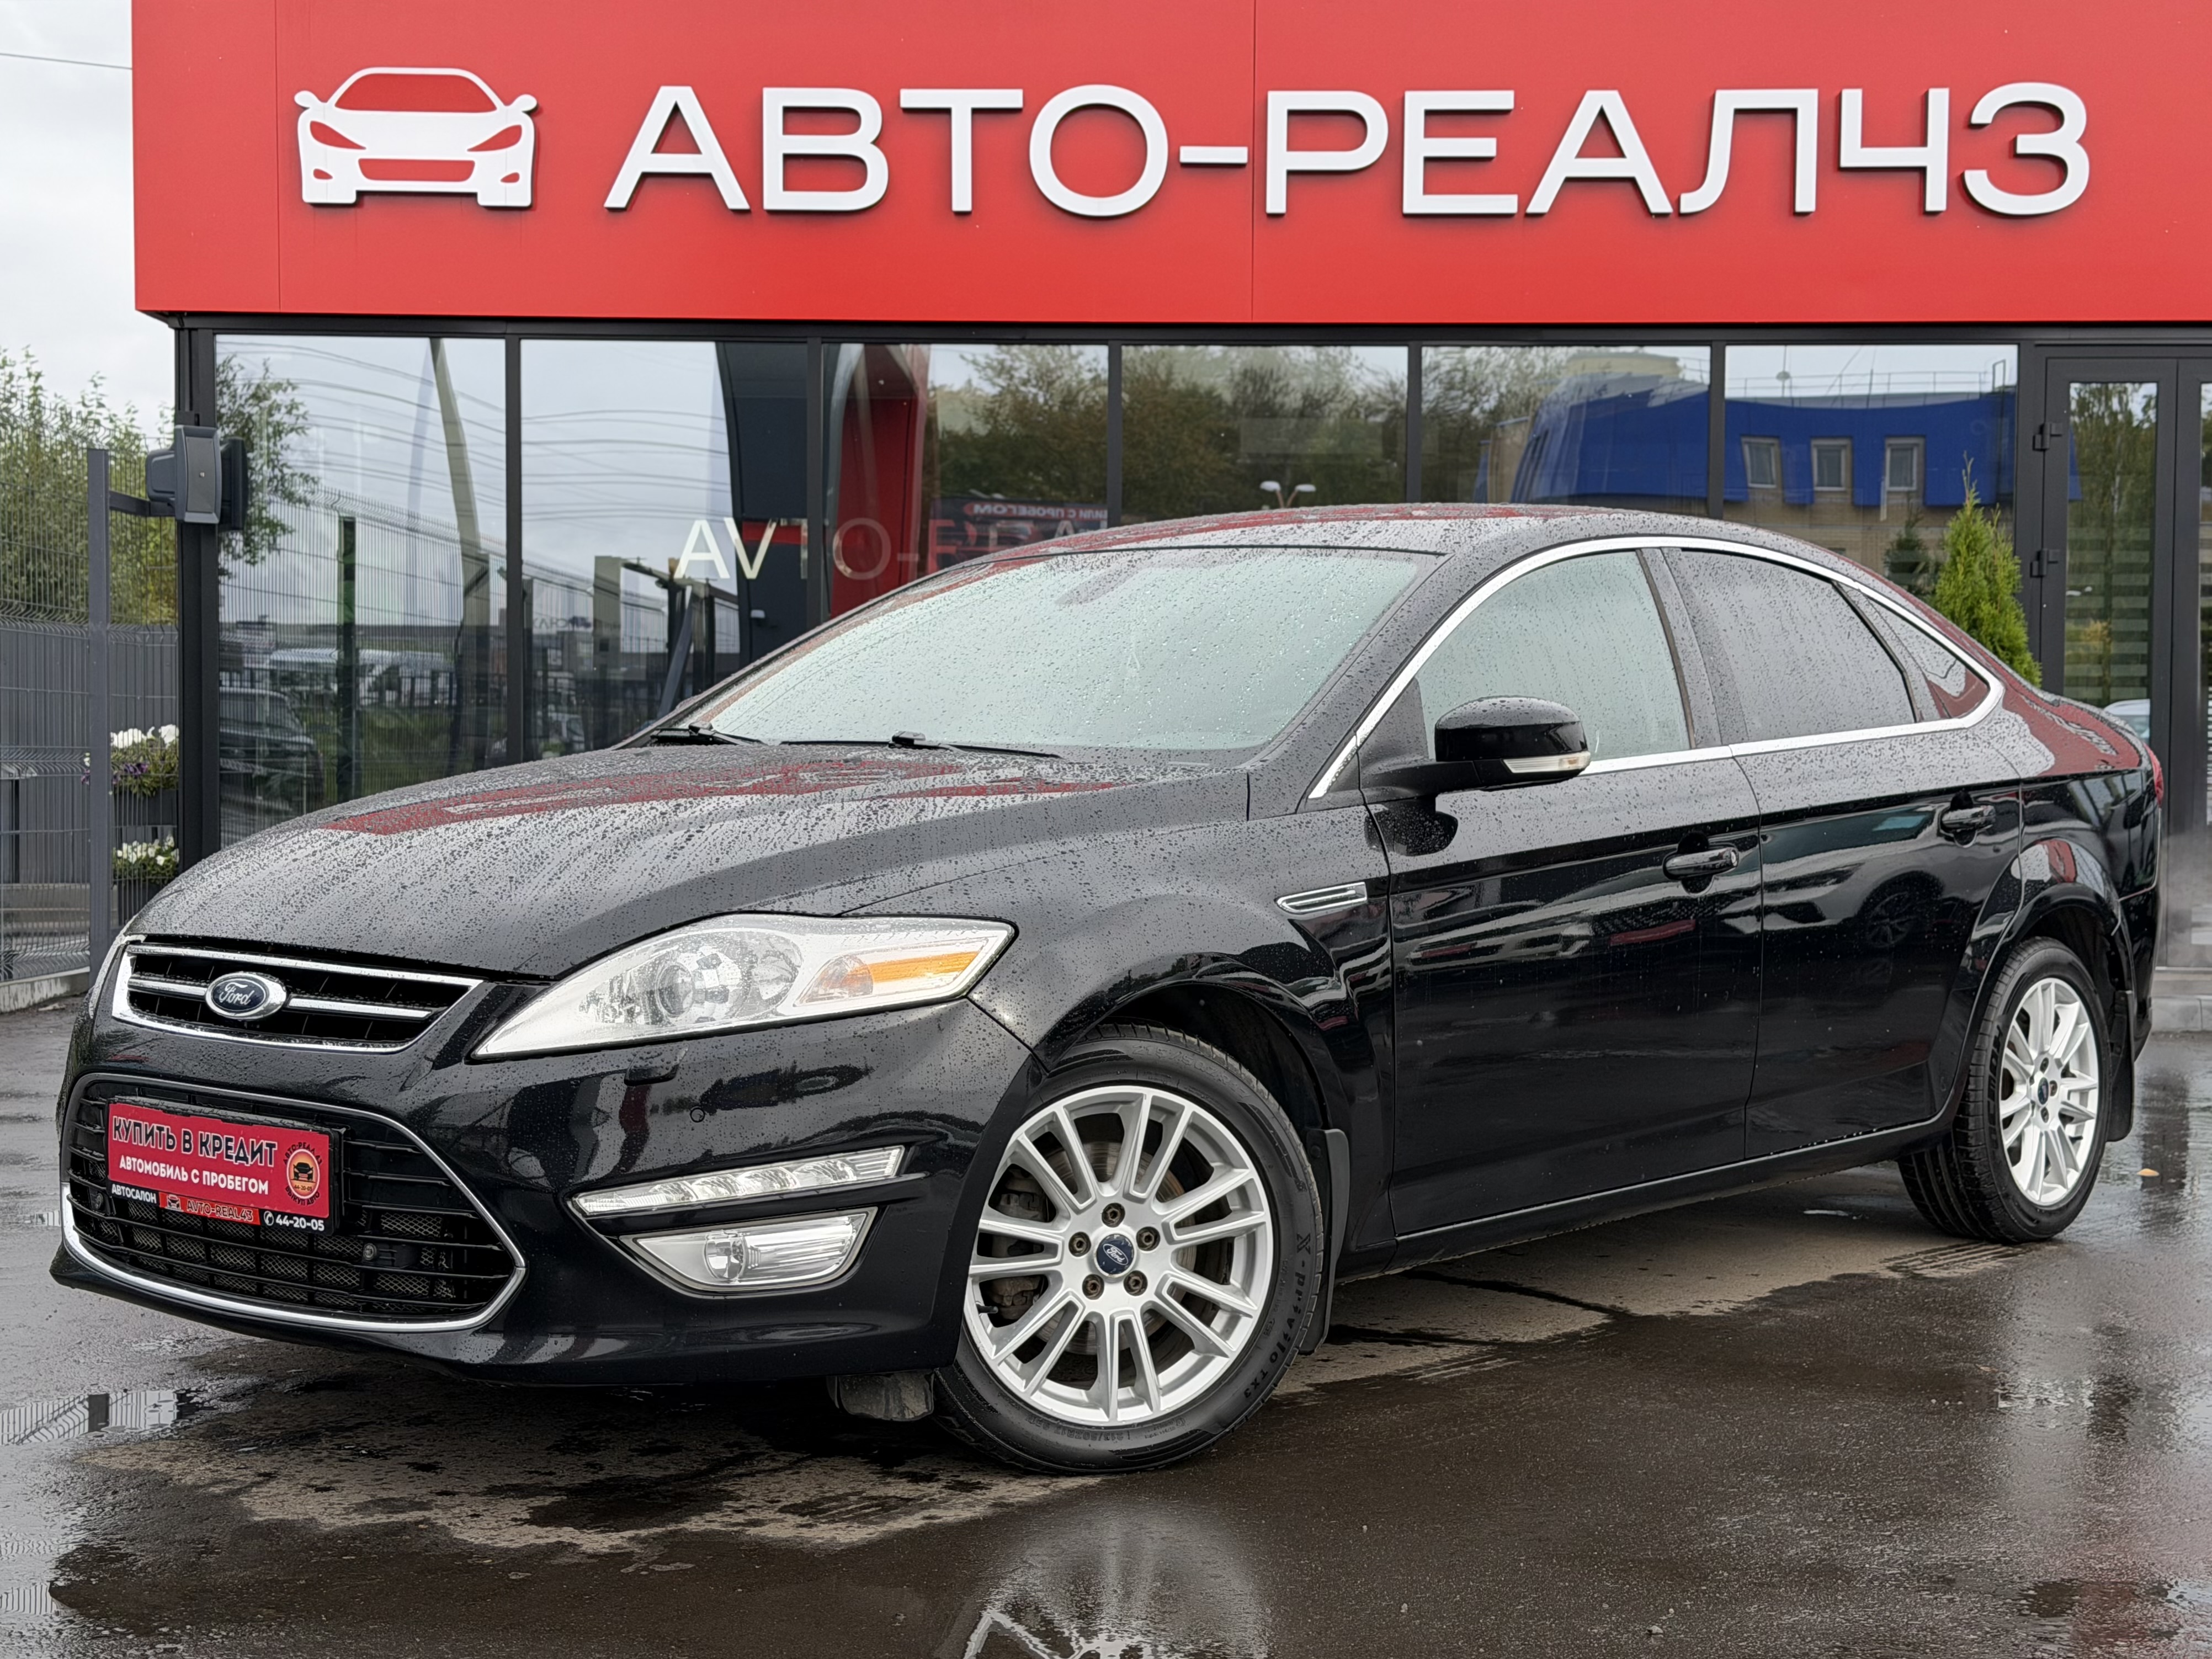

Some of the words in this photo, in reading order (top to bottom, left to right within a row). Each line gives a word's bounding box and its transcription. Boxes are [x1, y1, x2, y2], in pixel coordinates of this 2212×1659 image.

[219, 982, 256, 1006] Ford
[113, 1116, 177, 1151] КУПИТЬ
[182, 1129, 193, 1155] В
[199, 1131, 277, 1167] КРЕДИТ
[119, 1155, 188, 1182] АВТОМОБИЛЬ
[191, 1169, 199, 1184] С
[202, 1171, 268, 1195] ПРОБЕГОМ
[111, 1184, 157, 1204] АВТОСАЛОН
[307, 1190, 320, 1205] АВТО
[187, 1199, 254, 1222] AVTO-REAL43
[276, 1214, 325, 1231] 44-20-05
[1106, 1247, 1125, 1263] Ford
